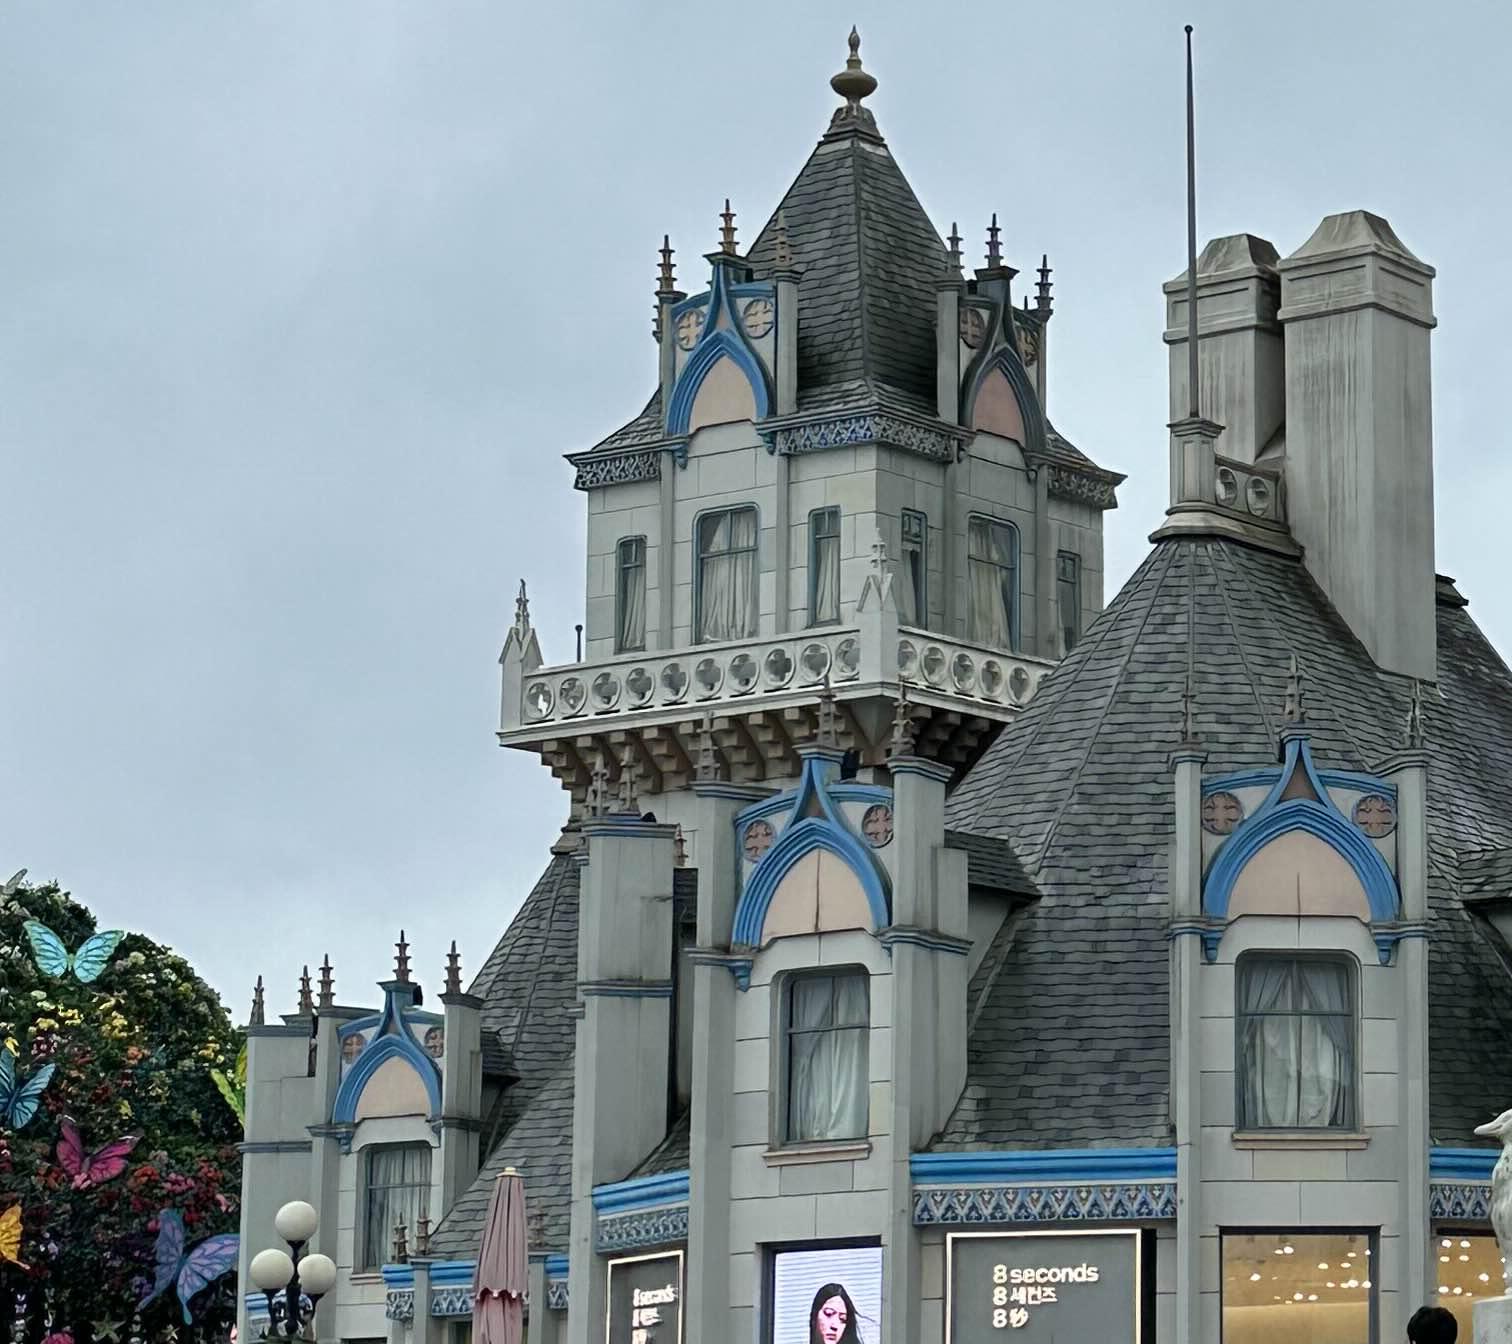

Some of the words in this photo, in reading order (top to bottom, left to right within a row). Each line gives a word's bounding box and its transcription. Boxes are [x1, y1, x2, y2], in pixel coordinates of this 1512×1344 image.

[993, 1264, 1008, 1284] 8
[1010, 1263, 1099, 1284] seconds
[993, 1286, 1008, 1306] 8
[1010, 1286, 1058, 1305] 세컨즈
[993, 1308, 1008, 1328] 8
